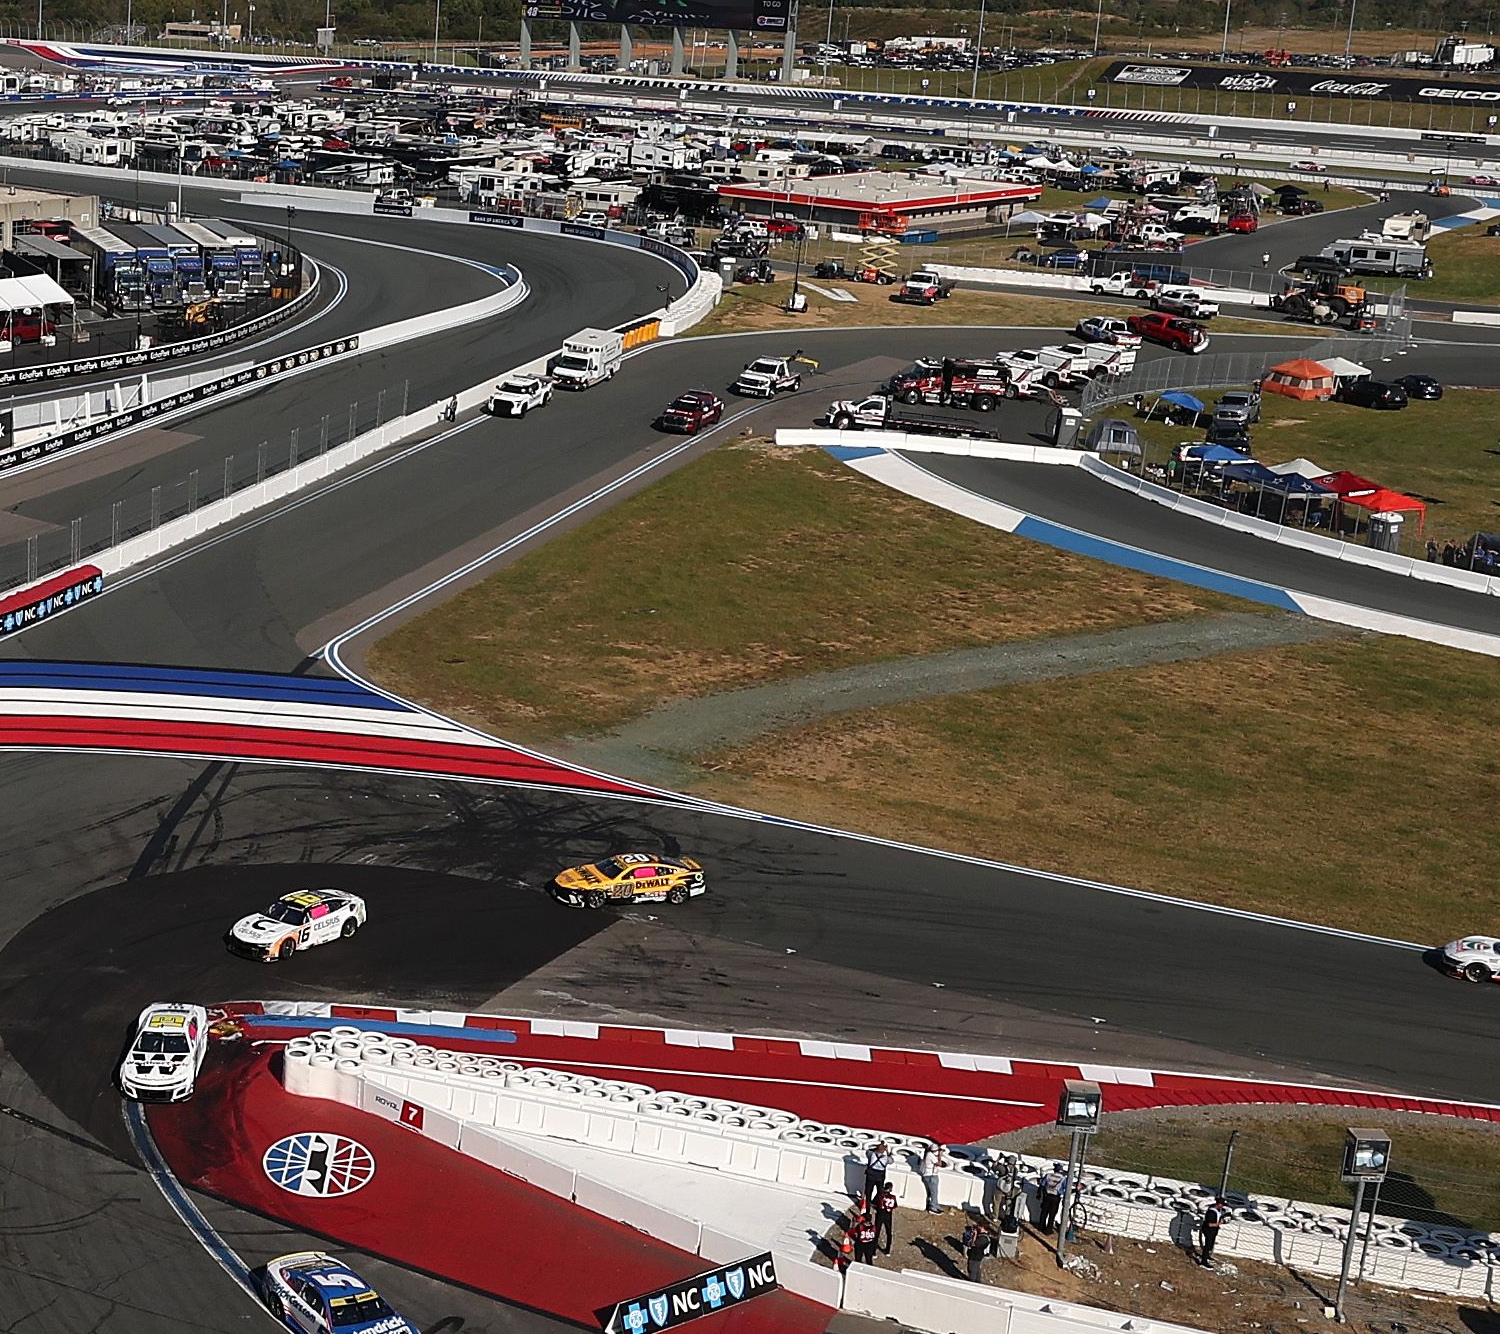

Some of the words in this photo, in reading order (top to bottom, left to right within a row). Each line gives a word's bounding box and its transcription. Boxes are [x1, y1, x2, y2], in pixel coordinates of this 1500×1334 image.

[608, 78, 730, 92] CHARLOTTE
[1220, 75, 1279, 88] BUSCH
[1309, 80, 1392, 96] Coca-Cola
[81, 581, 93, 595] NC
[622, 853, 650, 864] 20
[612, 882, 635, 899] 20
[313, 916, 341, 931] CELSIUS
[298, 925, 311, 945] 16
[408, 1107, 419, 1121] 7
[312, 1273, 367, 1289] 5
[672, 1288, 700, 1316] NC
[747, 1261, 774, 1289] NC
